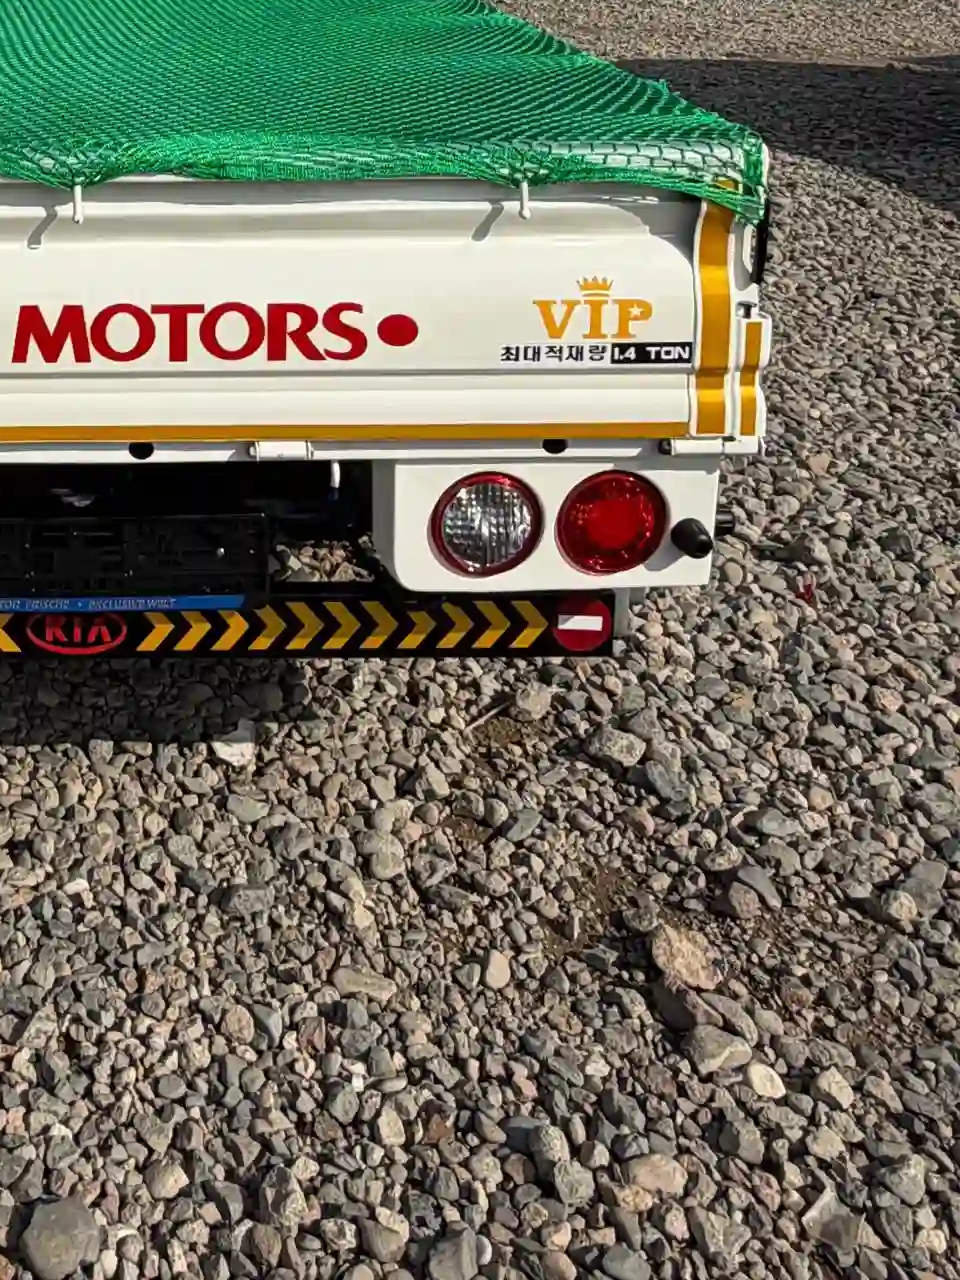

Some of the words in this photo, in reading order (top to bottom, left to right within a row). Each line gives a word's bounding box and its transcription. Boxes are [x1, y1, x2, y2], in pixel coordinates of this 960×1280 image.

[11, 301, 368, 363] MOTORS
[533, 298, 653, 339] VIP
[500, 345, 608, 362] 최대적재량
[613, 347, 637, 360] 1.4
[646, 346, 690, 360] TON
[45, 615, 112, 643] KIA
